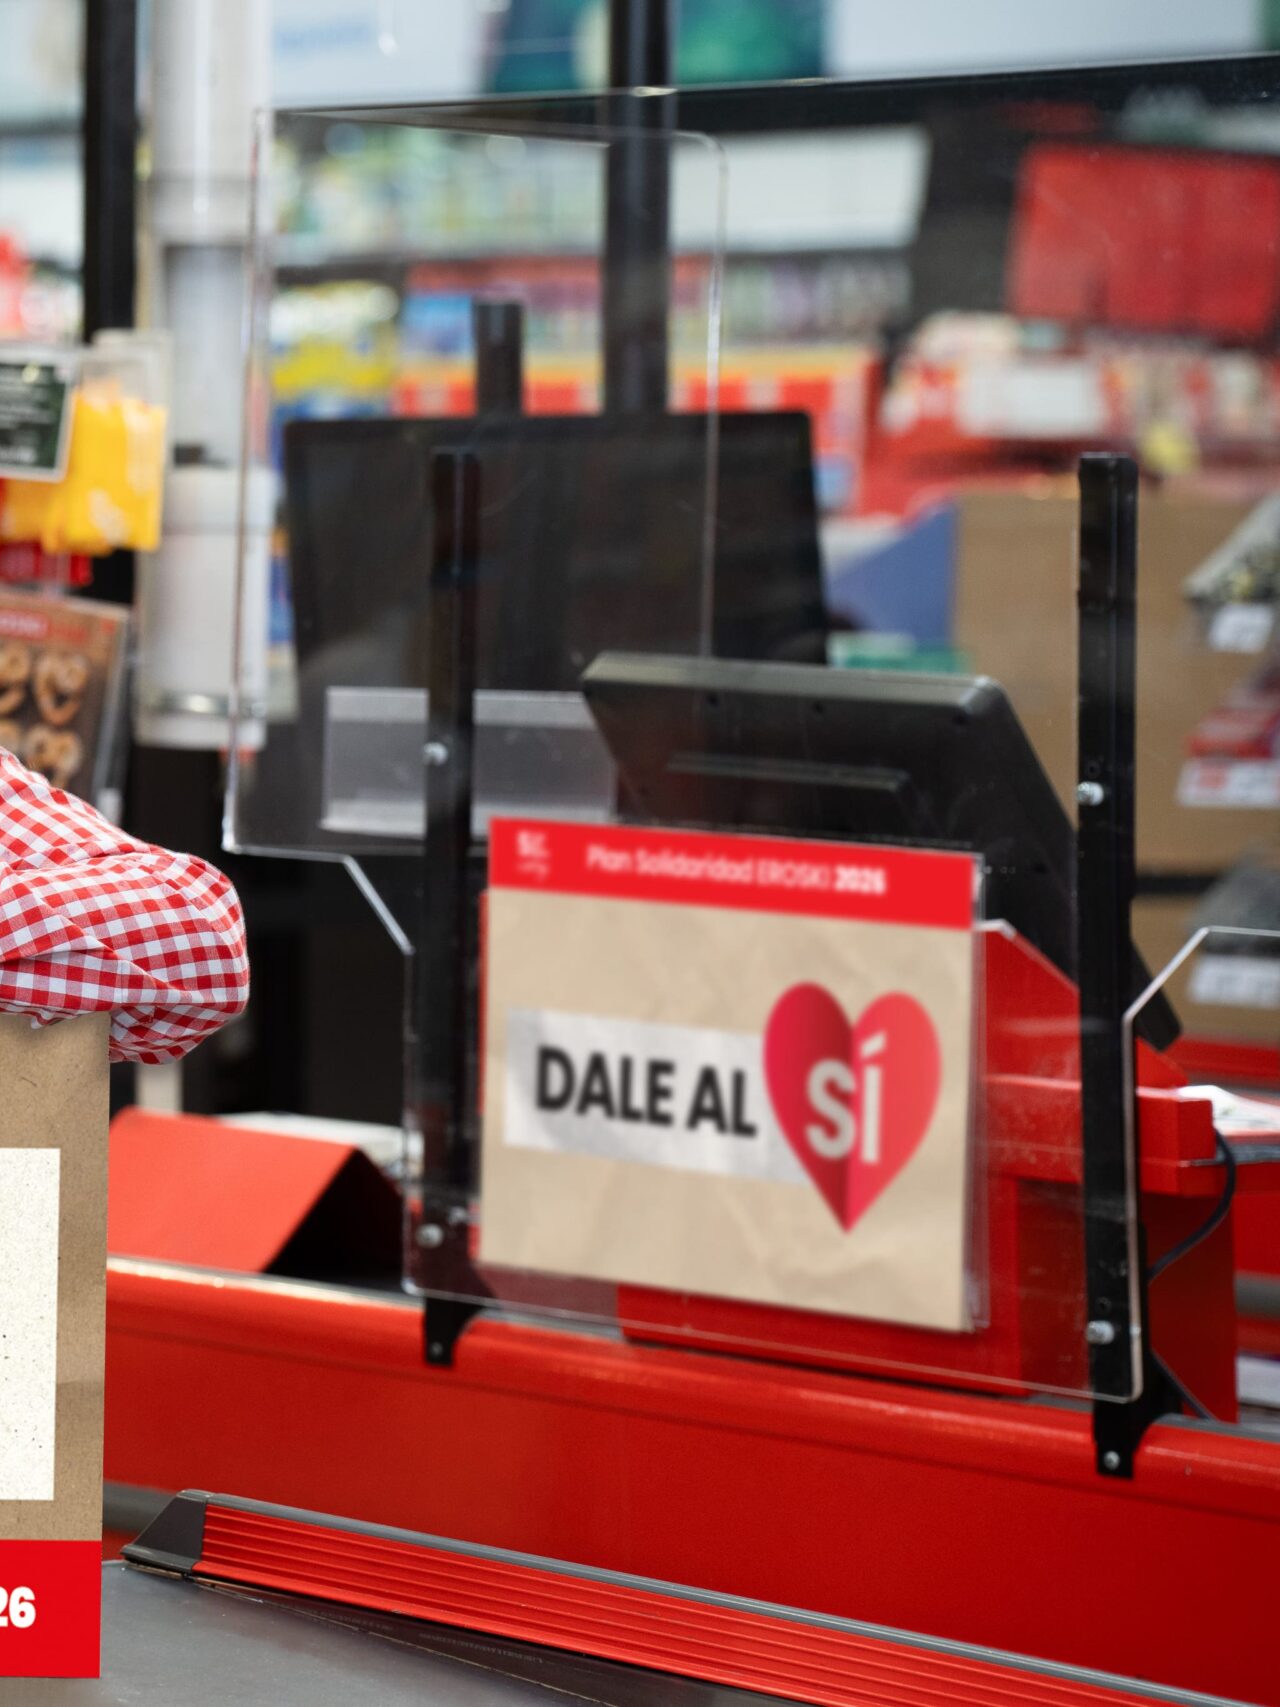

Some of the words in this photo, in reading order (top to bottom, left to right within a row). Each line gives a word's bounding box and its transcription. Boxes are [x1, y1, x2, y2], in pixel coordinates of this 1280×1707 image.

[586, 844, 633, 872] Plan
[636, 846, 753, 885] Solidaridad
[757, 859, 831, 891] EROSKI
[833, 864, 887, 894] 2026
[535, 1045, 676, 1127] DALE
[686, 1066, 758, 1138] AL
[805, 1031, 887, 1165] SÍ
